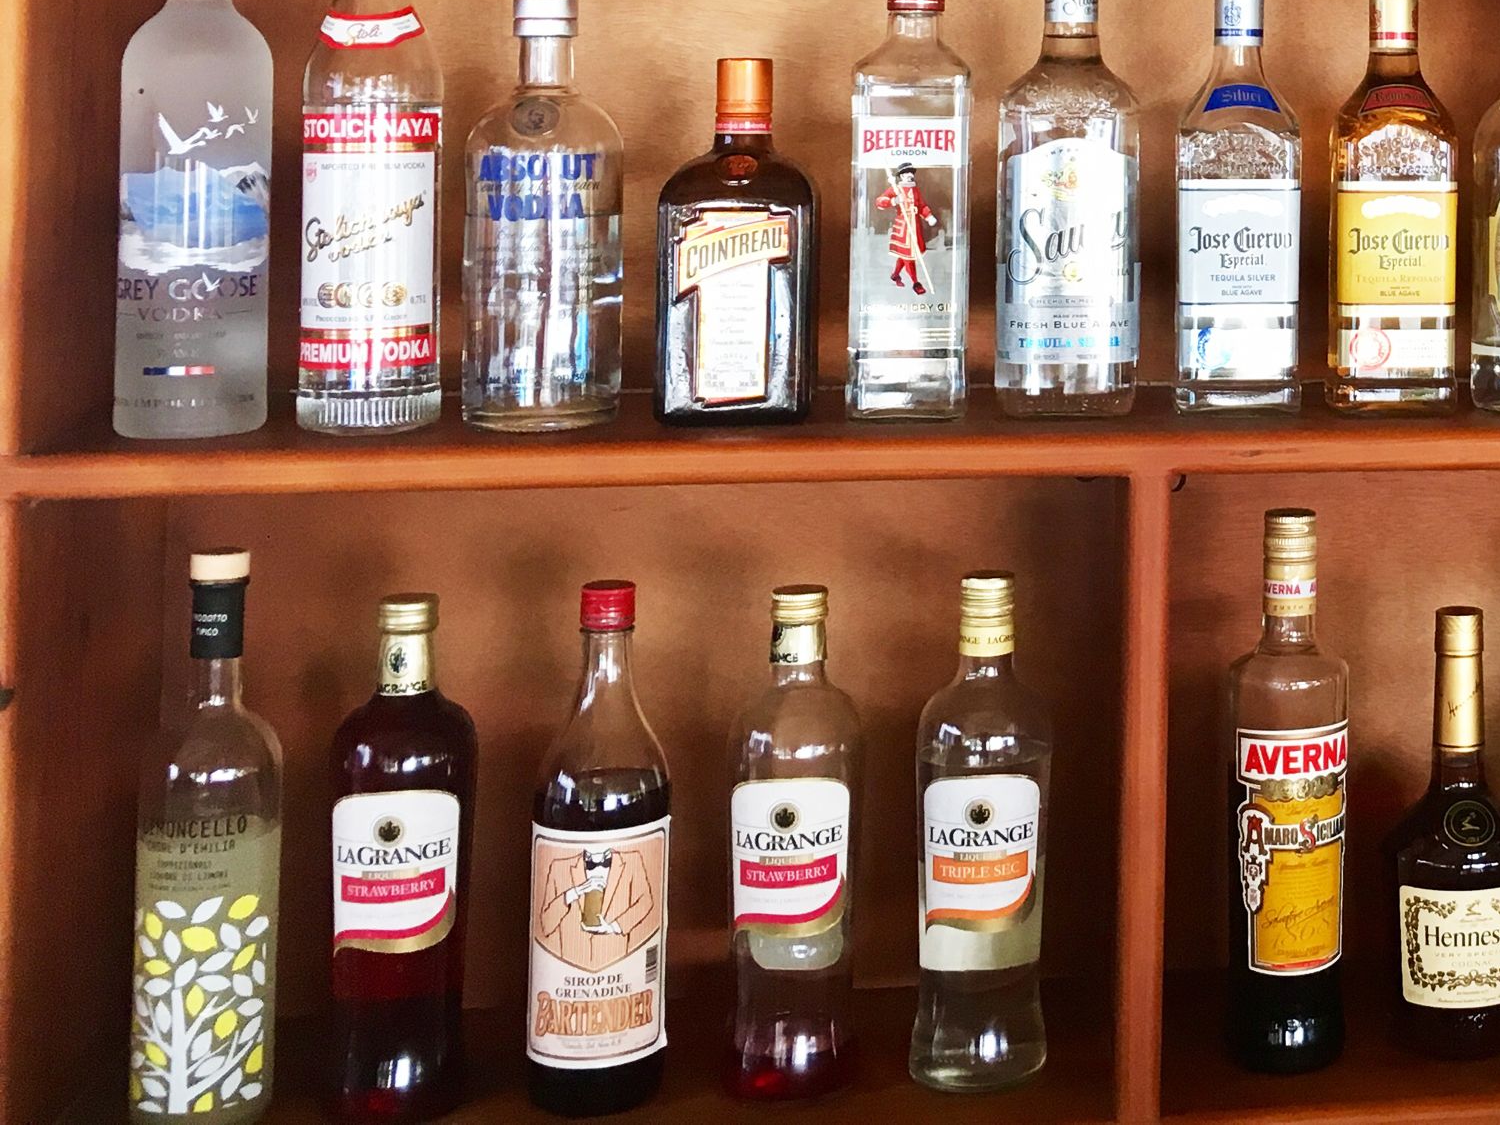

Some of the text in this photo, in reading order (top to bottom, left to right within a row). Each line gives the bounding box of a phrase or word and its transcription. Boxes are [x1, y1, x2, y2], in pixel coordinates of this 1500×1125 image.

[862, 129, 956, 154] BEEFEATER
[891, 149, 928, 157] LONDON
[479, 153, 597, 182] ABSOUT
[1189, 226, 1292, 253] Jose Cuervo
[1348, 227, 1450, 254] Jose Cuervo
[686, 227, 783, 279] COINTREAU
[1220, 252, 1265, 269] Especial
[1378, 254, 1422, 270] Especial
[1210, 274, 1276, 282] TEQUILA SILVER
[1221, 288, 1262, 296] BLUE AGAVE
[138, 307, 223, 322] VODKA
[1009, 319, 1129, 329] FRESH BLUE AAVE
[1244, 735, 1347, 775] AVERNA
[1243, 815, 1299, 856] AMARO
[745, 863, 830, 882] STRAWBERRY
[940, 860, 1020, 878] TRIPLE SEC
[347, 878, 436, 898] STRAWBERRY
[564, 973, 623, 986] SIROP DE
[555, 983, 632, 999] GRENADINE
[535, 988, 654, 1037] BARTENDER
